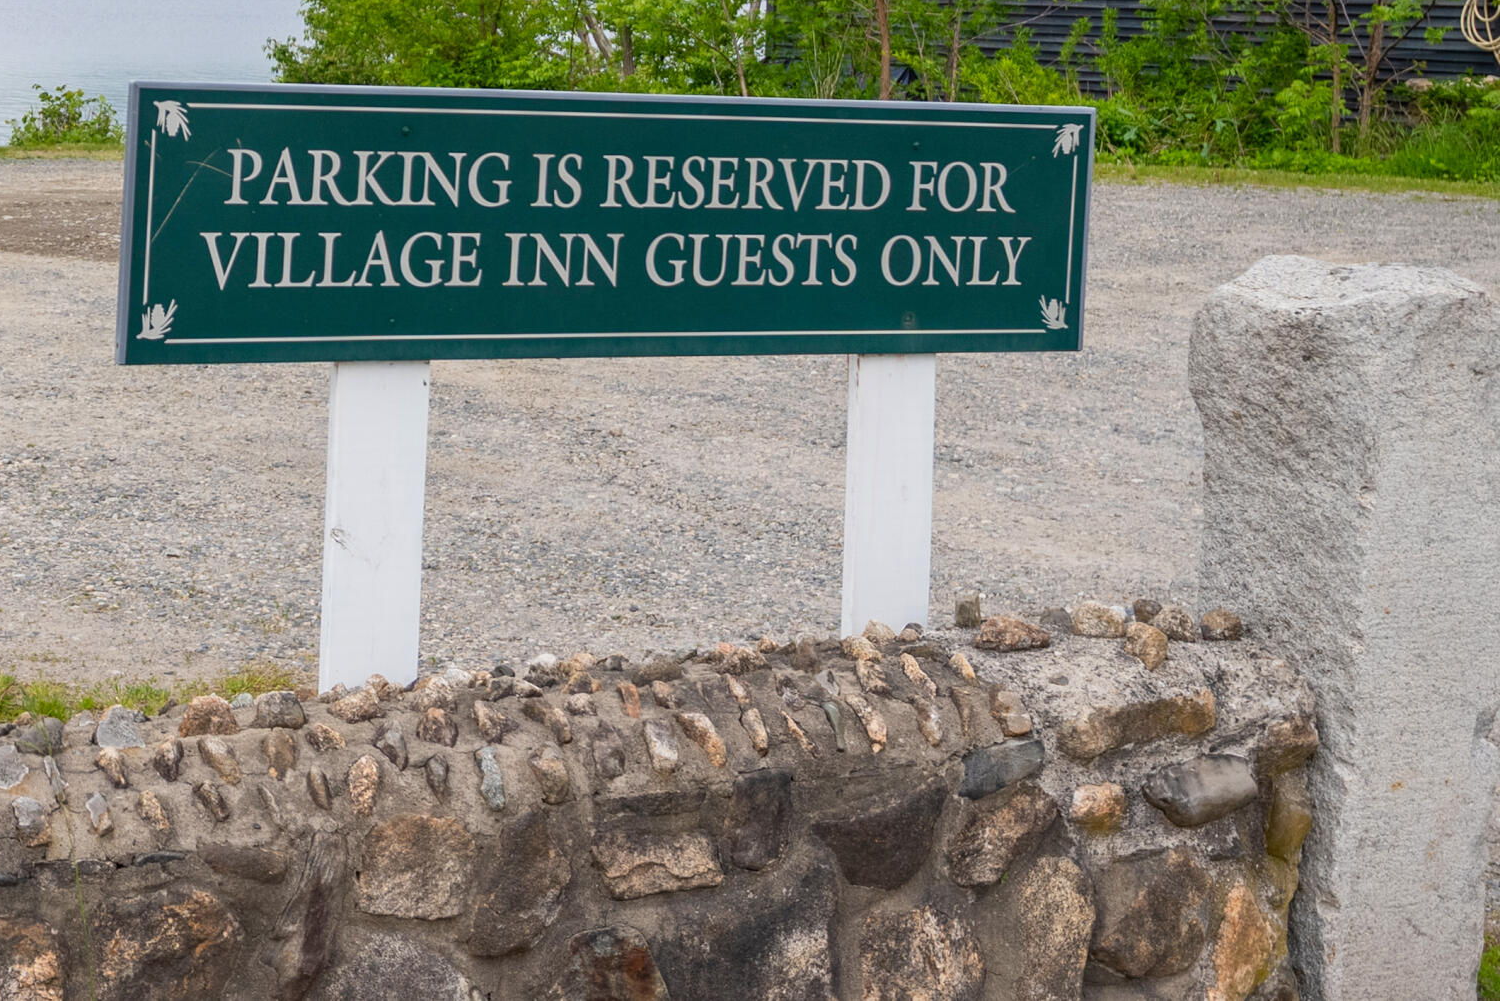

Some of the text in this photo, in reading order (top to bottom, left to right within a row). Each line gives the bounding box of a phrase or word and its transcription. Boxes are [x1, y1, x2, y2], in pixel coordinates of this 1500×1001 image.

[224, 147, 1016, 213] PARKING IS RESERVED FOR
[200, 230, 1032, 291] VILLAGE INN GUESTS ONLY
